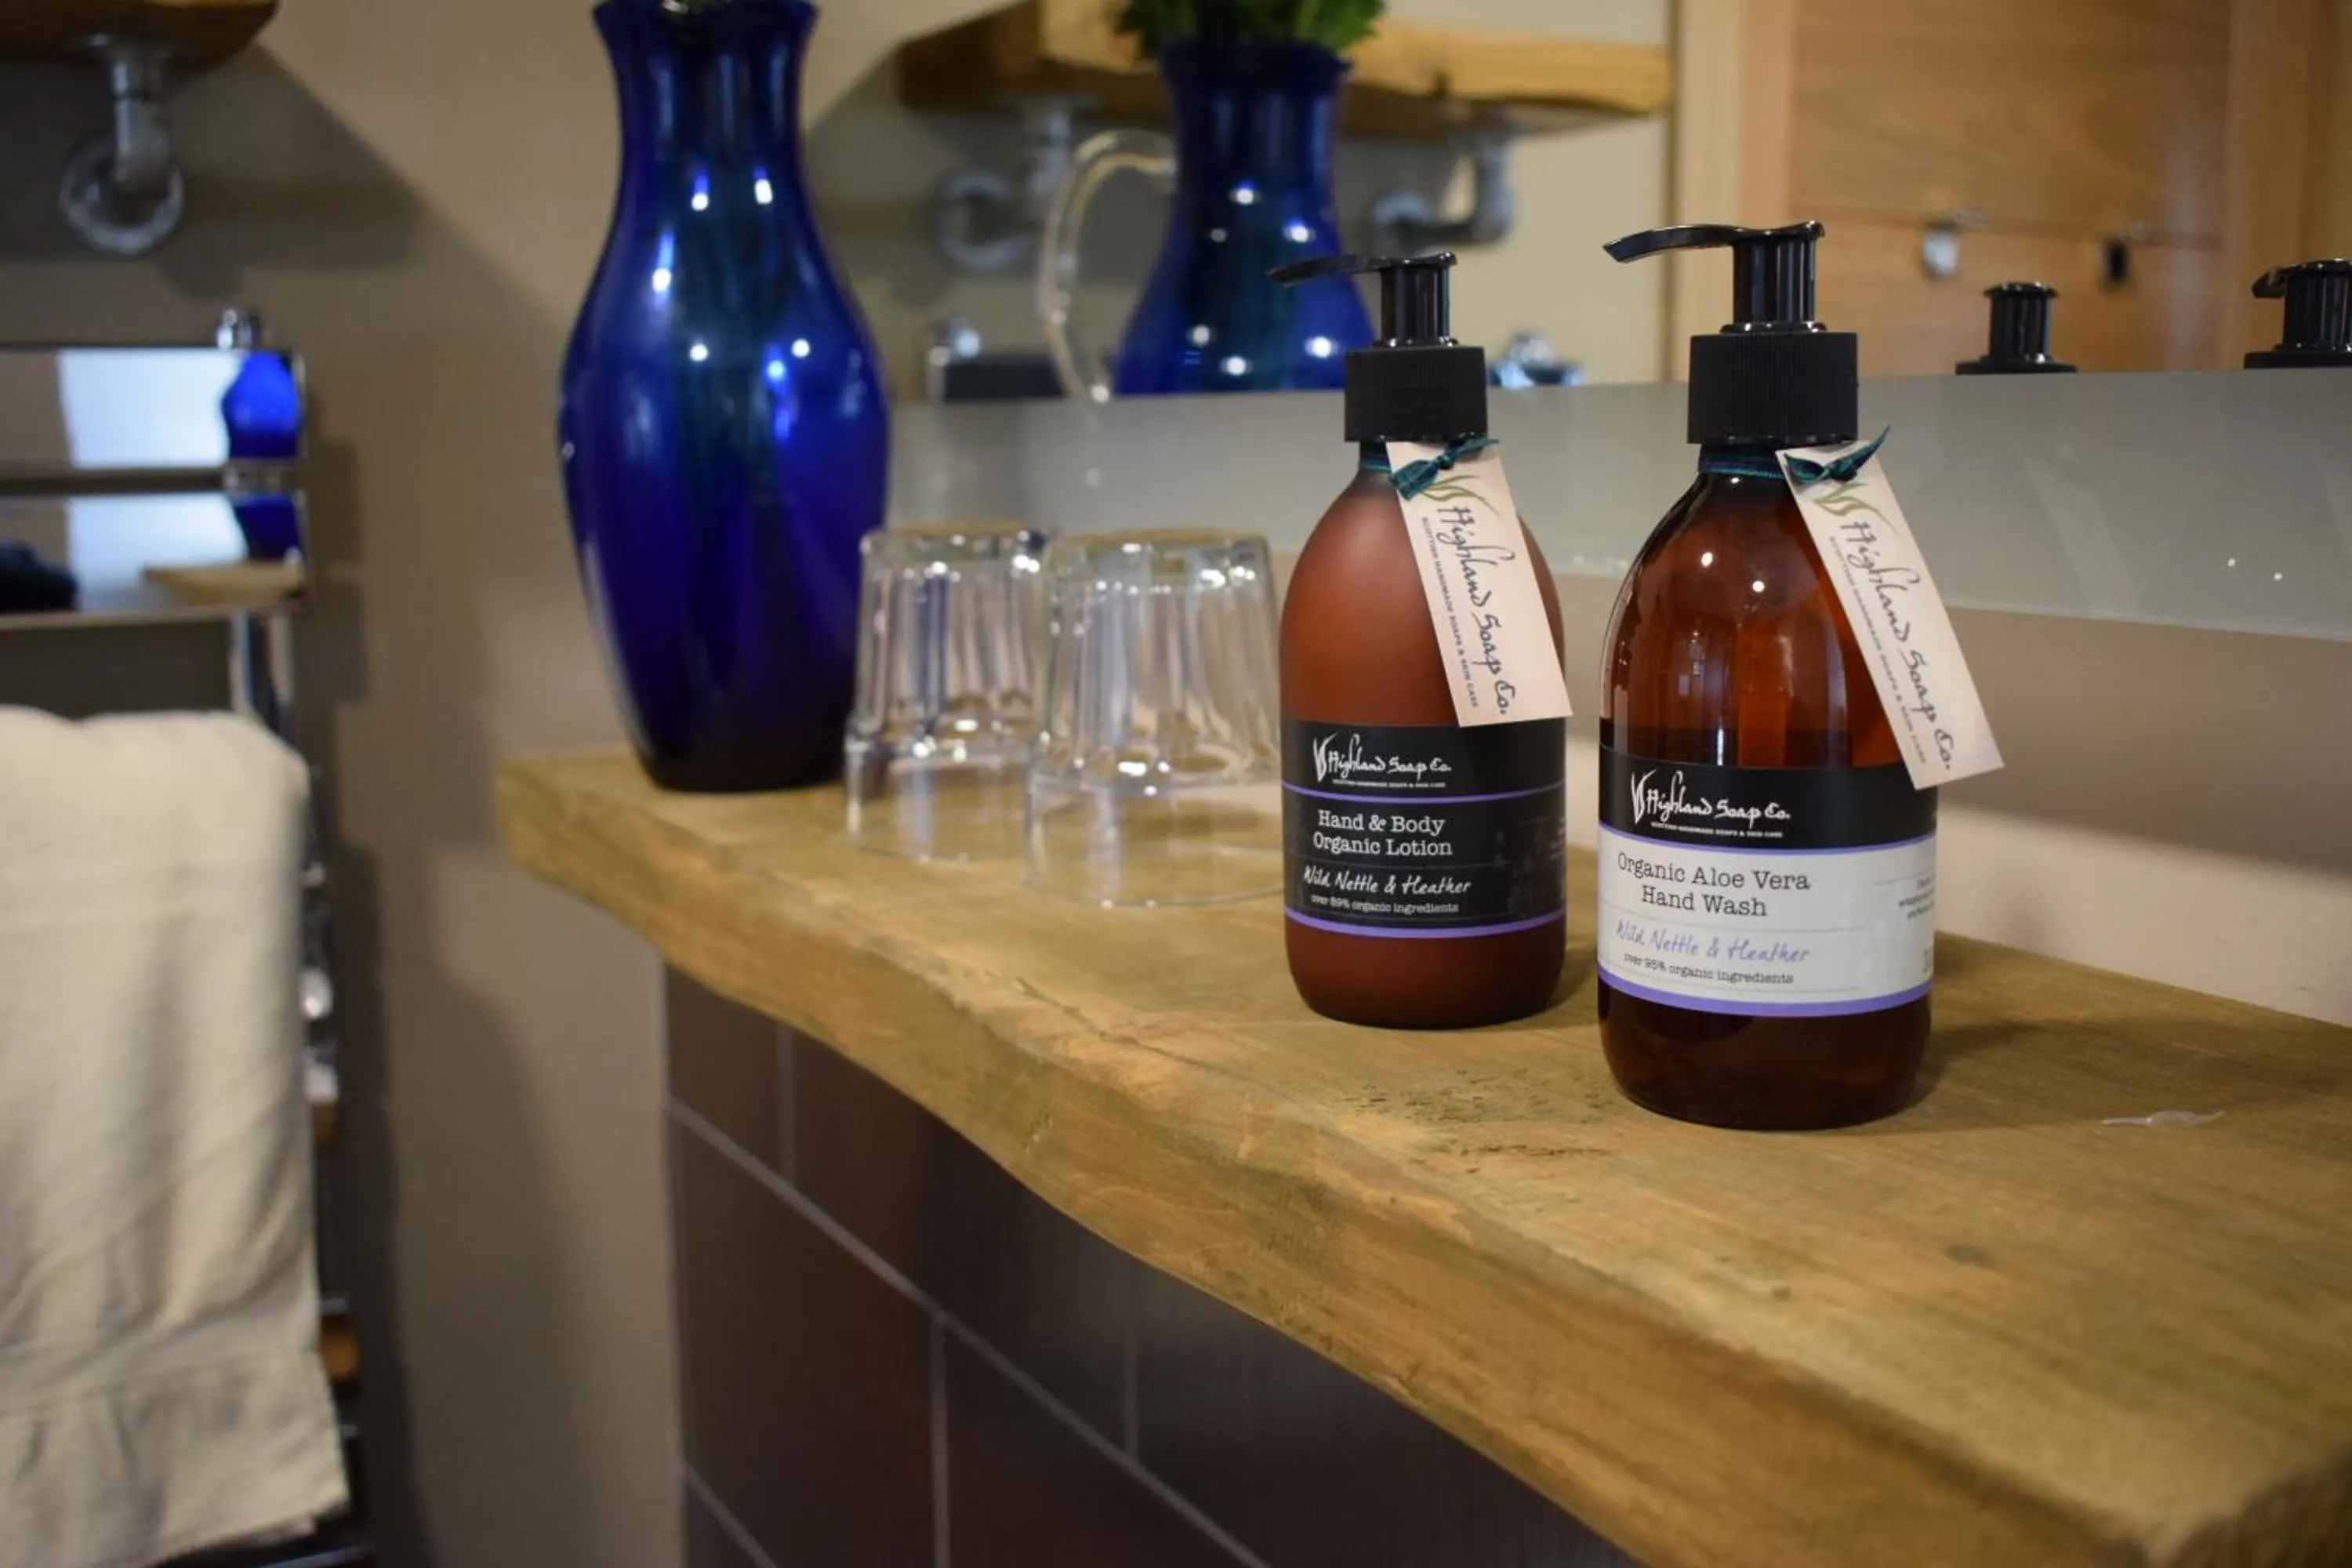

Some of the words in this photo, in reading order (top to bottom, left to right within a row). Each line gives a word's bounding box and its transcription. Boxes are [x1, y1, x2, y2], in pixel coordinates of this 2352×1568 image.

[1436, 505, 1515, 608] Highland
[1470, 611, 1502, 676] Soap
[1839, 520, 1921, 644] Highland
[1897, 648, 1937, 724] Soap
[1933, 727, 1954, 770] Co.
[1494, 679, 1515, 715] Co.
[1328, 733, 1386, 779] Highland
[1386, 755, 1428, 781] Soap
[1429, 757, 1452, 772] Co.
[1647, 771, 1713, 822] Highland
[1714, 798, 1762, 829] Soap
[1764, 802, 1791, 820] Co.
[1318, 809, 1364, 831] Hand
[1368, 815, 1387, 832] &
[1390, 815, 1446, 837] Body
[1313, 831, 1381, 855] Organic
[1385, 838, 1453, 856] Lotion
[1304, 865, 1330, 887] Wild
[1334, 869, 1379, 893] Nettle
[1384, 874, 1396, 895] &
[1402, 874, 1472, 895] Heather
[1617, 852, 1686, 883] Organic
[1691, 866, 1745, 888] Aloe
[1752, 870, 1810, 890] Vera
[1352, 901, 1392, 913] organic
[1393, 902, 1459, 915] ingredients
[1642, 884, 1694, 911] Hand
[1701, 894, 1768, 916] Wash
[1615, 918, 1645, 946] Wild
[1650, 927, 1700, 956] Nettle
[1704, 937, 1720, 959] &
[1727, 938, 1810, 963] Heather
[1668, 964, 1714, 978] organic
[1716, 969, 1795, 984] ingredients
